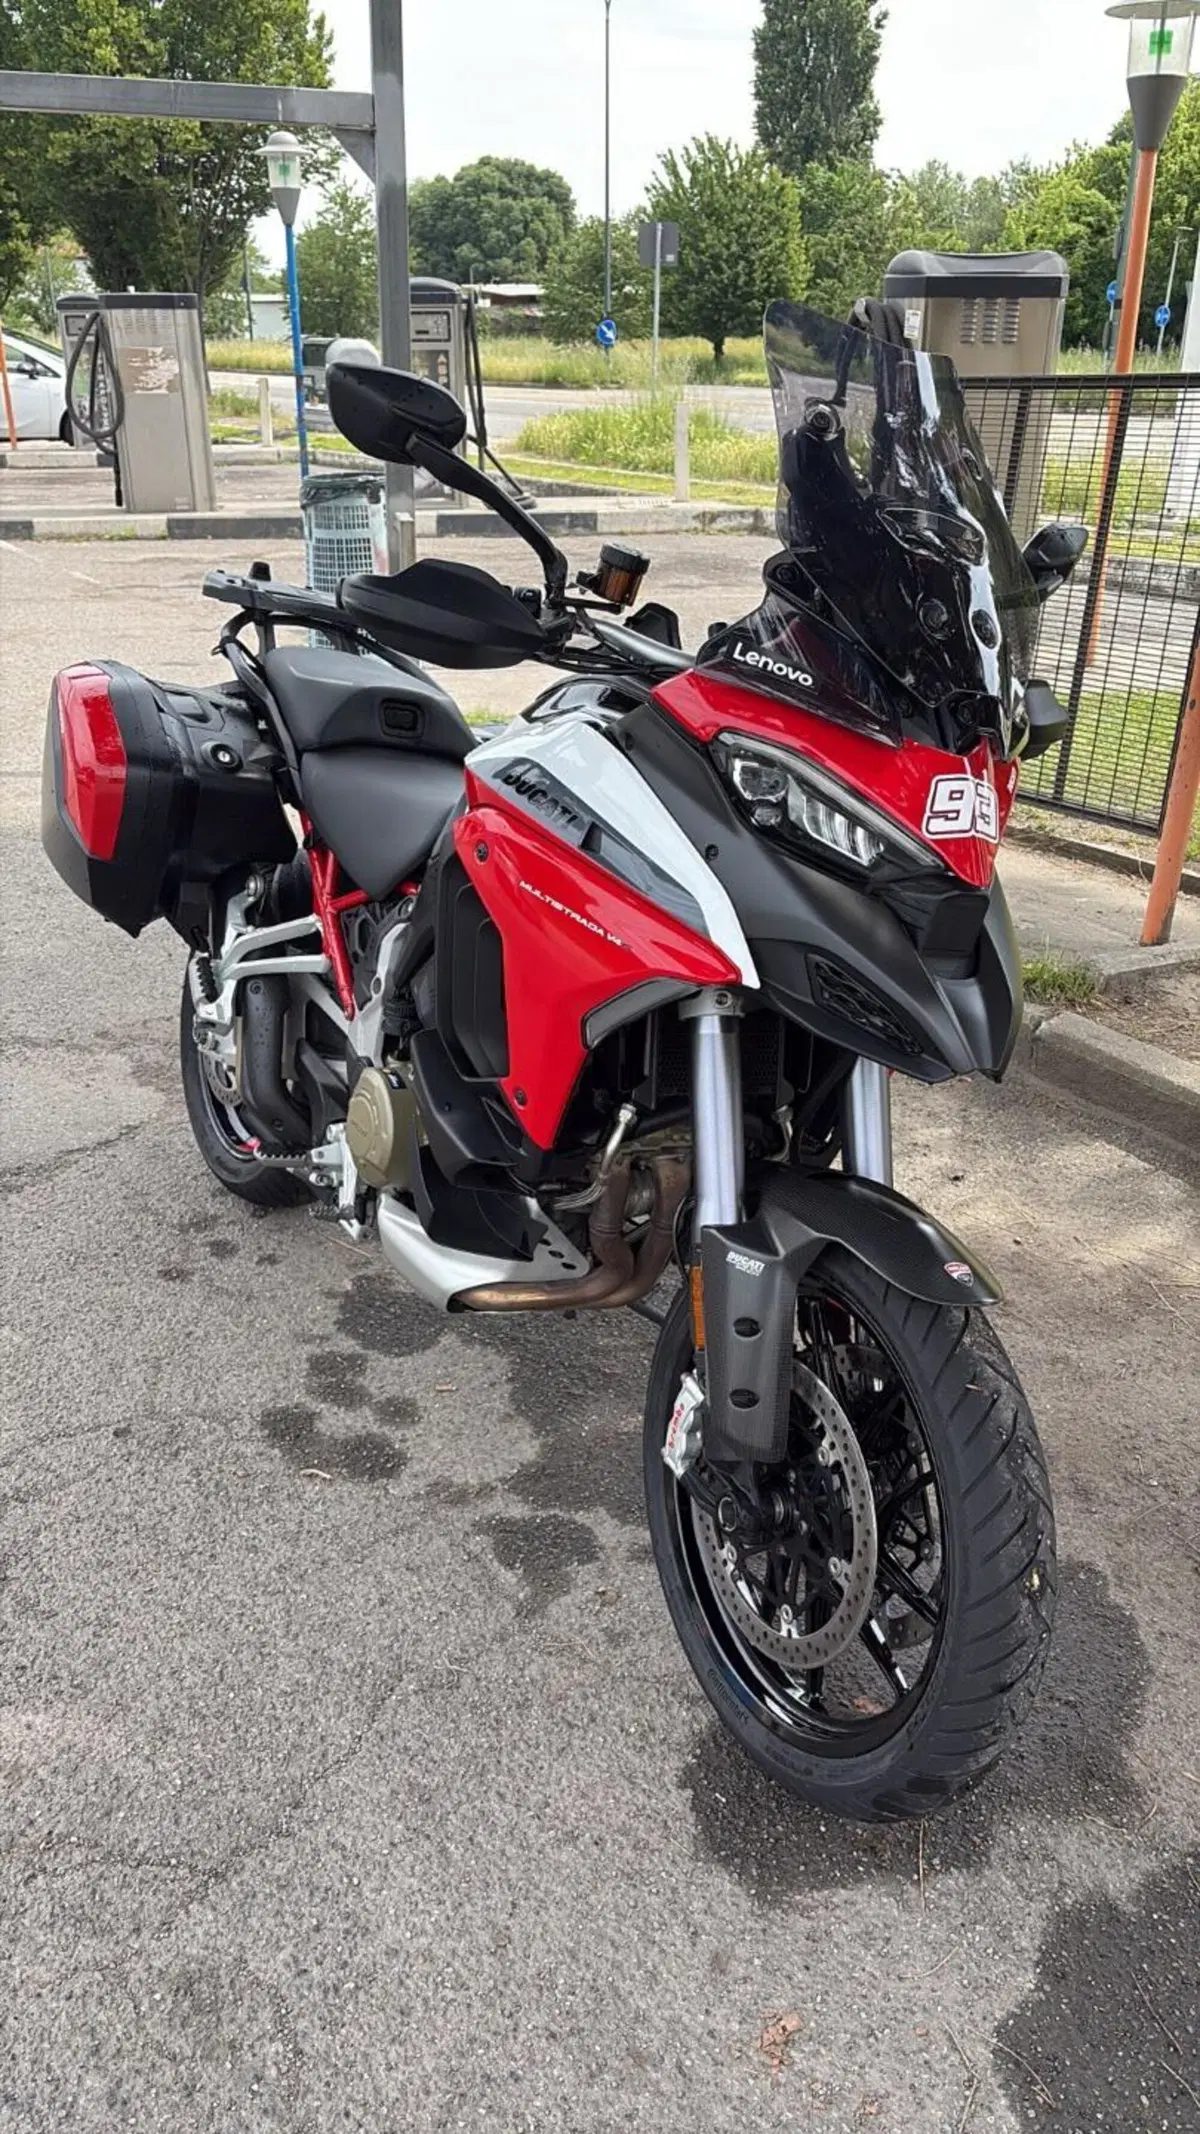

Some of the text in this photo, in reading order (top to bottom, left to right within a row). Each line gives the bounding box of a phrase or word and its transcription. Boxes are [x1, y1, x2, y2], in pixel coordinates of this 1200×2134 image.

[733, 642, 813, 686] Lenovo
[501, 770, 579, 831] DUCATI
[519, 880, 605, 937] MULTISTRADA
[726, 1250, 766, 1272] DUCATI
